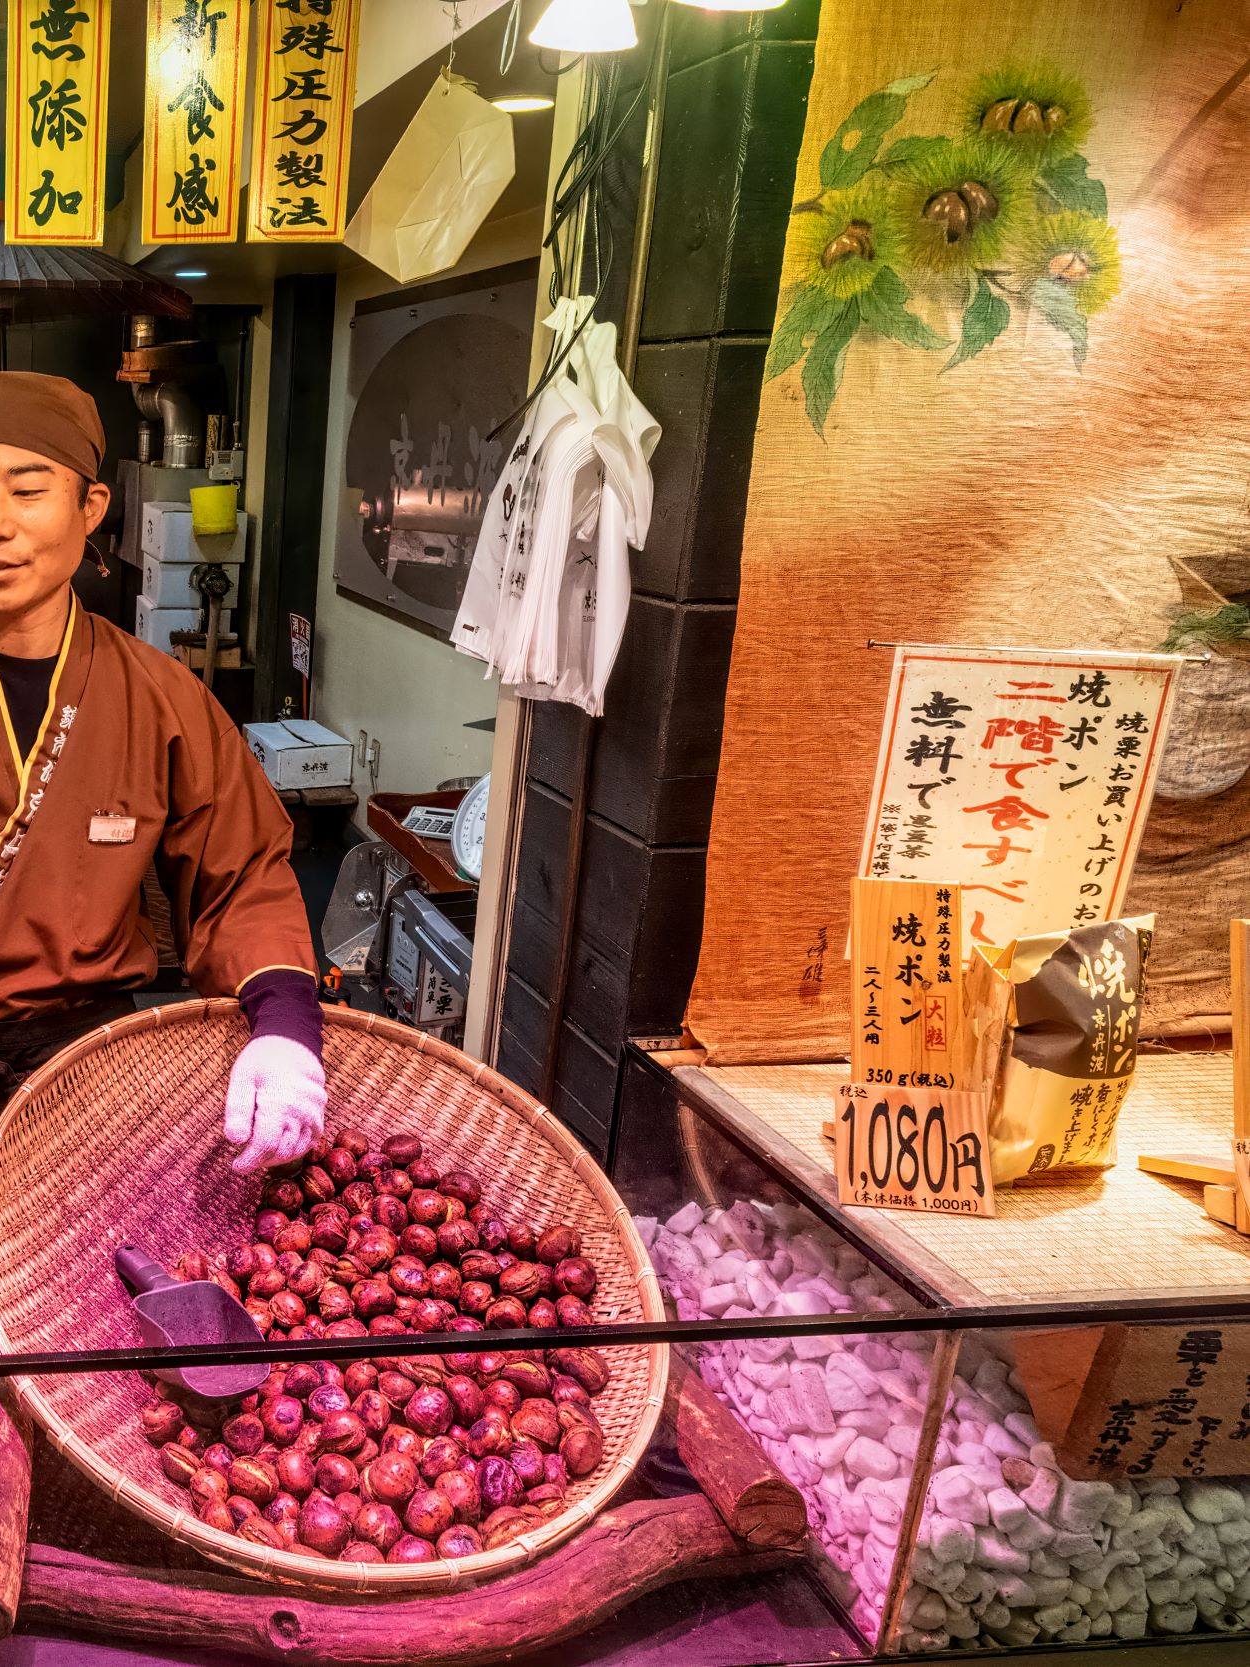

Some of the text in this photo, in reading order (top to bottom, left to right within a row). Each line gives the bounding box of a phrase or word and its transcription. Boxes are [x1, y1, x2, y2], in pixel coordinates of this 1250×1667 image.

[28, 0, 90, 226] 無添加
[903, 691, 973, 811] 無料で
[1059, 670, 1112, 792] 焼ポン
[1071, 711, 1150, 931] 焼栗お買い上げのお
[891, 912, 928, 1026] 焼ポン
[935, 888, 953, 984] 特殊圧力製法
[925, 999, 947, 1047] 大粒
[1078, 938, 1137, 1073] 焼ポン
[1090, 1008, 1107, 1073] 京丹波
[839, 1085, 869, 1099] 税込
[866, 1068, 893, 1085] 350
[841, 1098, 986, 1198] 1,080円
